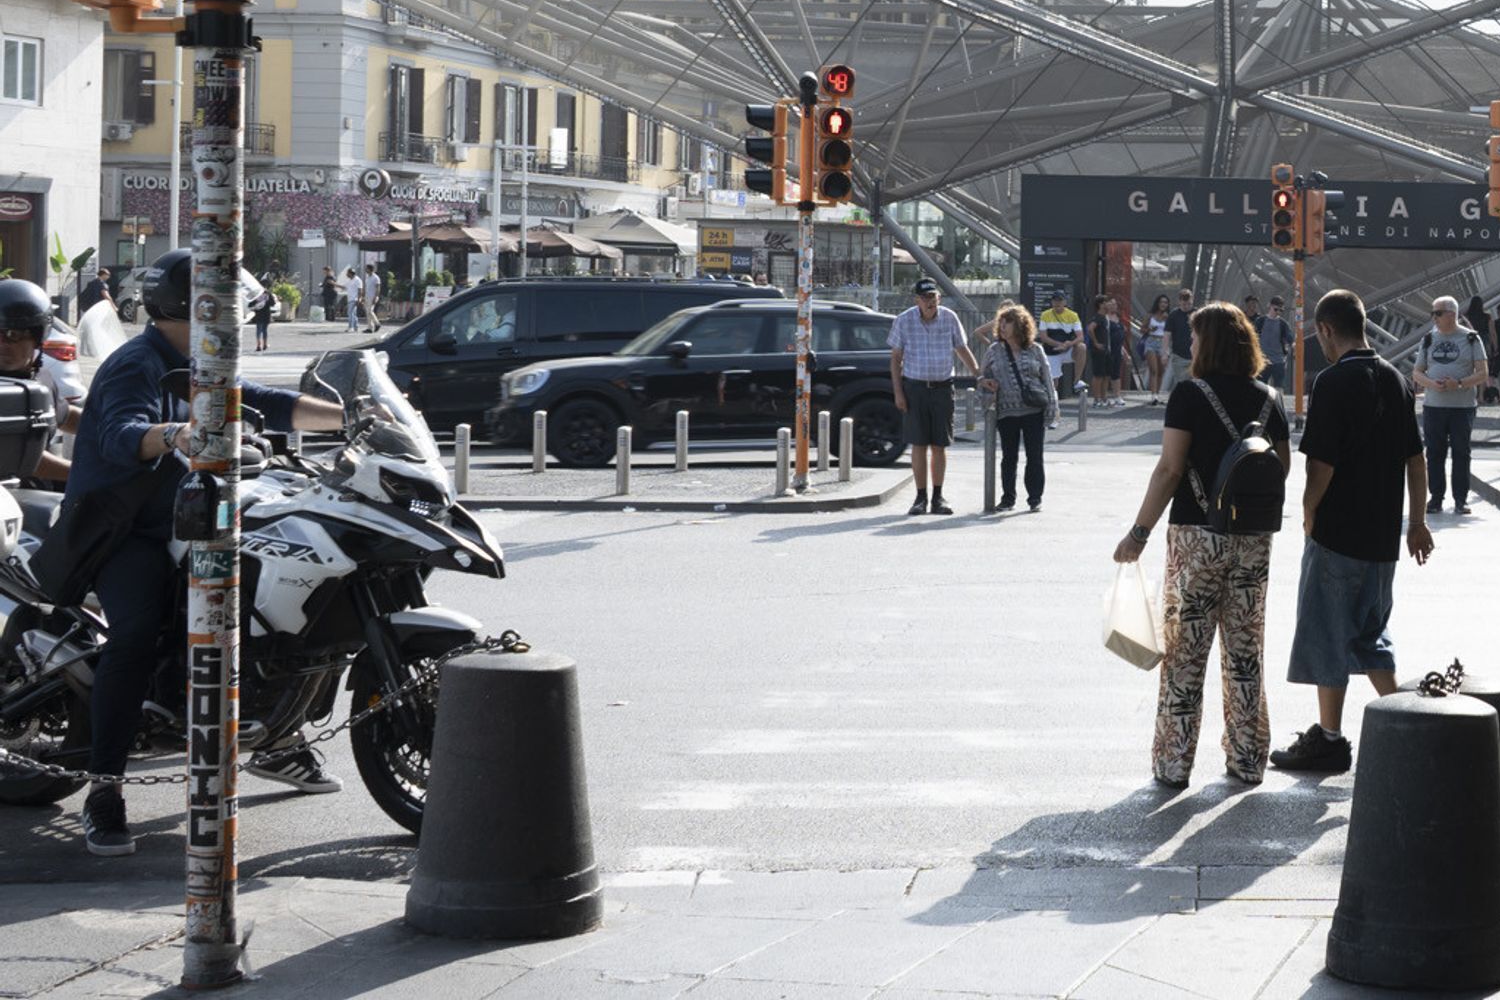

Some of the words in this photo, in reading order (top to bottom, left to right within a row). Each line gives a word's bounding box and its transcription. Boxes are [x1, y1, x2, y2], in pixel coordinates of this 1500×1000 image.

[828, 72, 848, 92] 48
[245, 178, 311, 192] LIATELLA
[1128, 190, 1409, 218] GALLIA
[1244, 223, 1366, 237] STNE
[1385, 226, 1409, 238] DI
